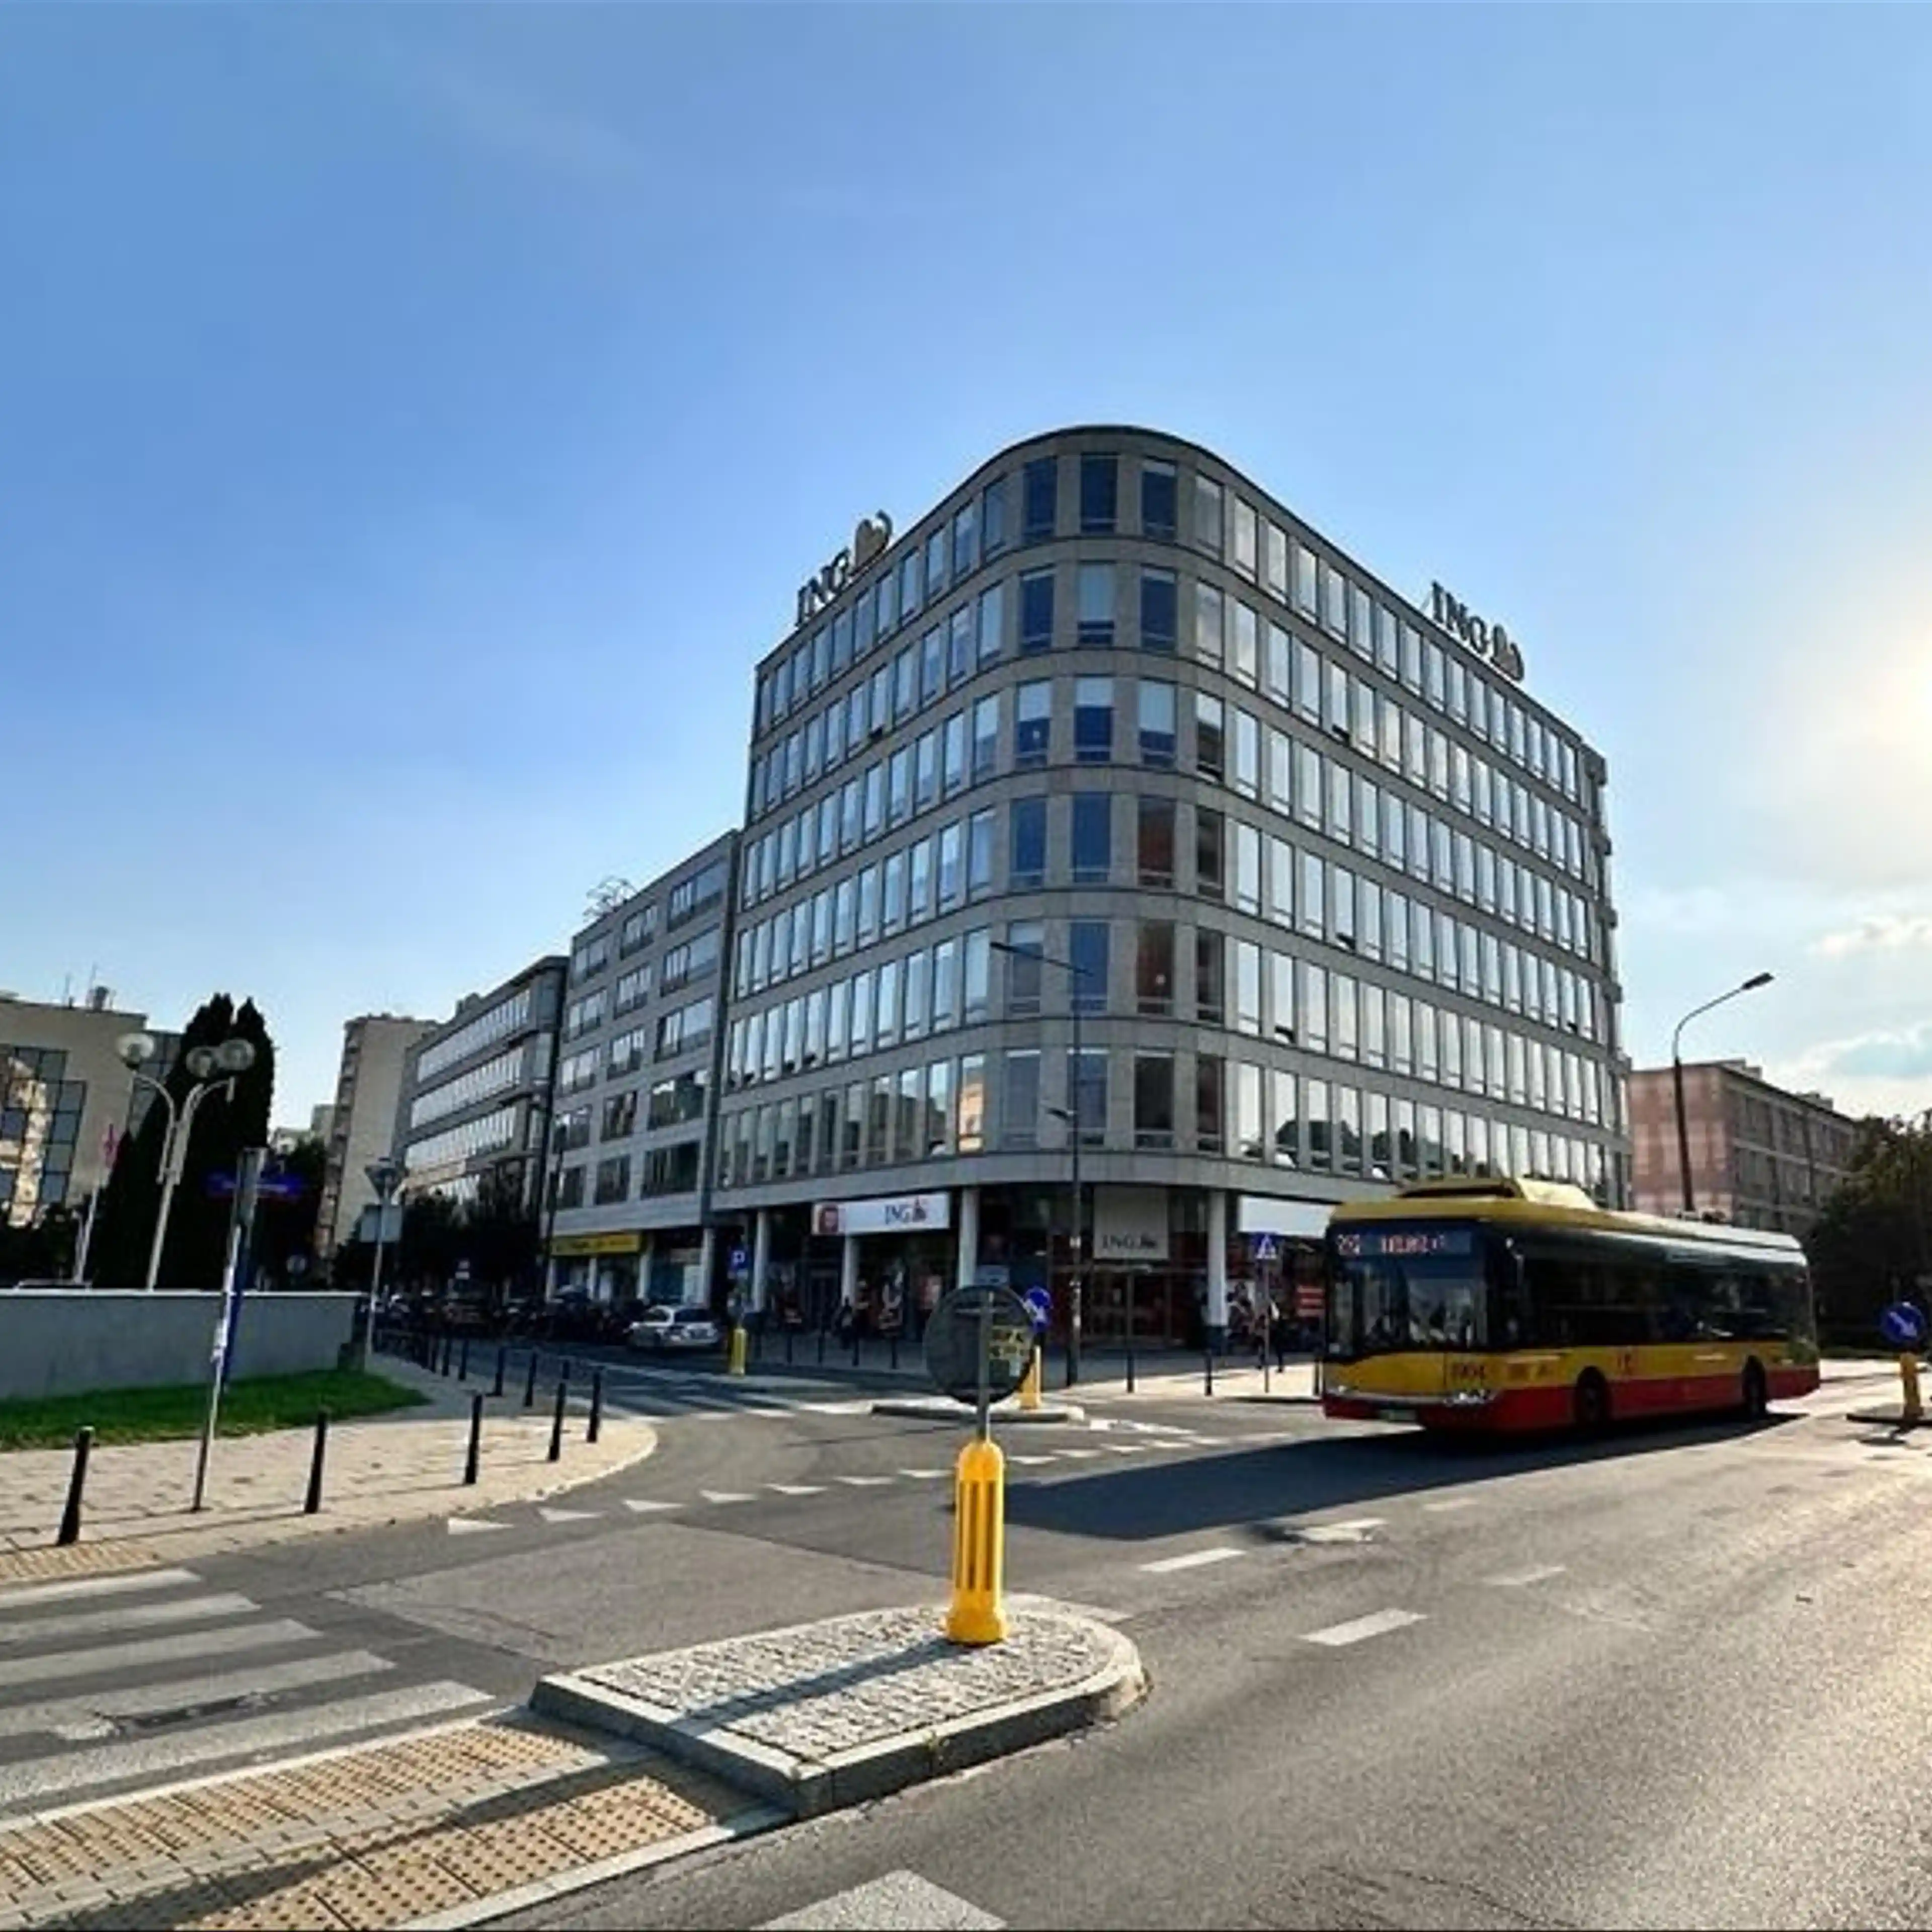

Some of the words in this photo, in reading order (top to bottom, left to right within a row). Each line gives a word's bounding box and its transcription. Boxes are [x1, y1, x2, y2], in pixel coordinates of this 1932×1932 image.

[795, 547, 849, 626] ING
[1432, 580, 1489, 654] ING
[884, 1204, 911, 1224] ING
